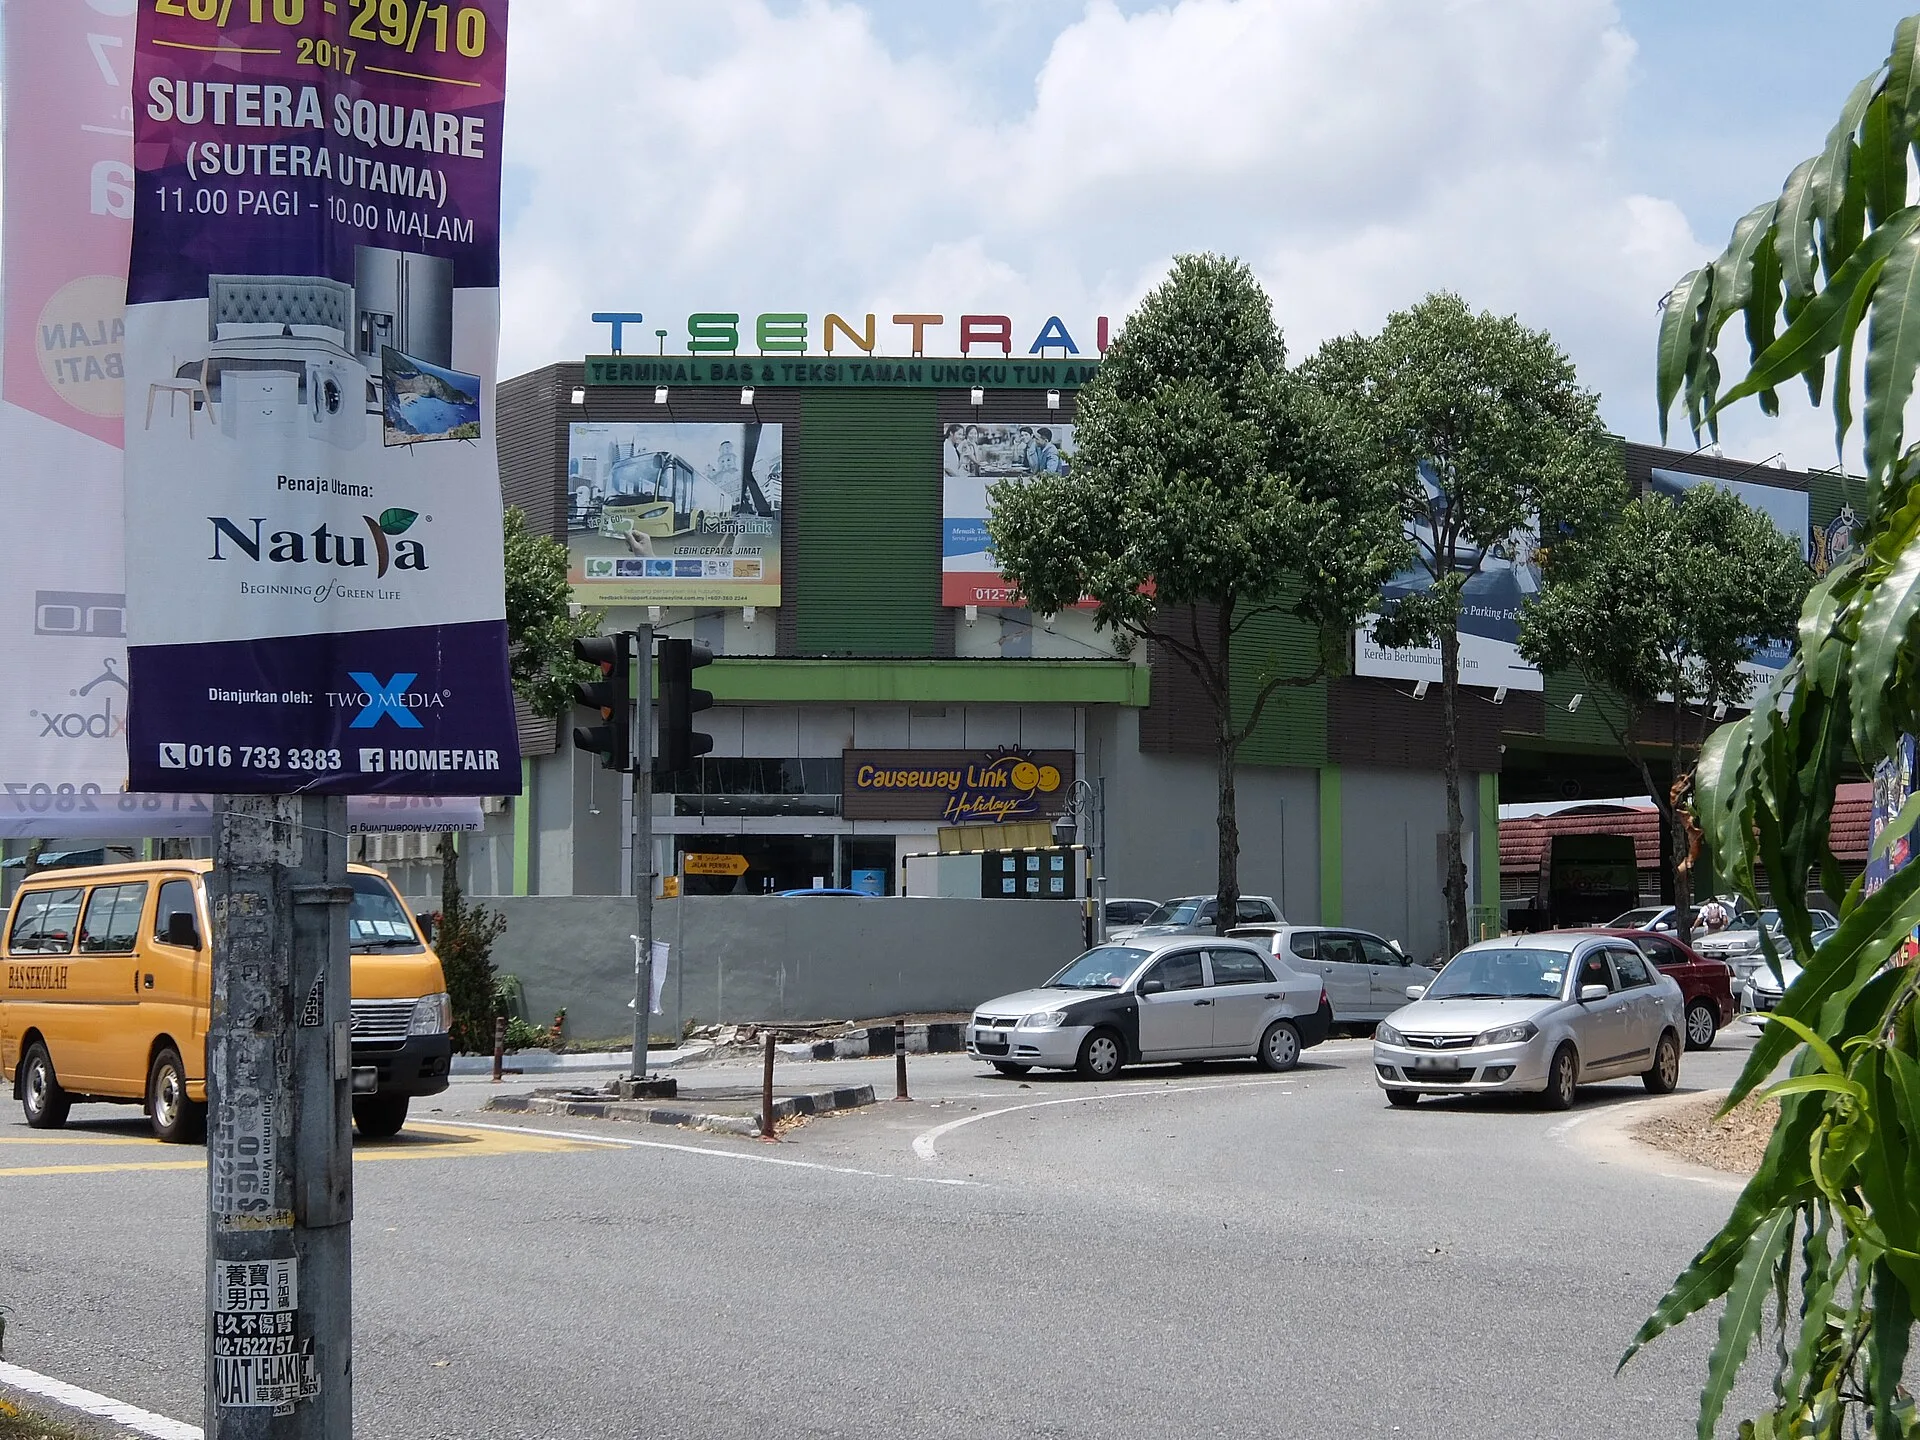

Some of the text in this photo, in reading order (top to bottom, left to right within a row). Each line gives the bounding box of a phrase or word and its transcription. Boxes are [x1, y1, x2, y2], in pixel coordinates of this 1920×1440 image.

[348, 0, 486, 58] 29/10
[296, 38, 357, 75] 2017
[147, 77, 485, 159] SUTERA SQUARE
[186, 141, 447, 208] (SUTERA UTAMA)
[156, 187, 228, 216] 11.00
[238, 189, 300, 216] PAGI
[328, 195, 379, 230] 10.00
[387, 209, 474, 244] MALAM
[591, 363, 702, 382] TERMINAL
[710, 363, 754, 382] BAS
[761, 364, 775, 382] &
[781, 364, 844, 383] TEKSI
[850, 364, 922, 383] TAMAN
[931, 365, 1006, 384] UNGKU
[1013, 366, 1055, 384] TUN
[277, 475, 374, 498] Penaja Utama:
[588, 518, 601, 528] TAP
[673, 546, 698, 555] LEBIH
[699, 546, 726, 555] CEPAT
[735, 546, 762, 555] JIMAT
[313, 578, 336, 603] of
[1470, 605, 1502, 621] Parking
[1364, 648, 1392, 661] Kereta
[1463, 657, 1479, 669] Jam
[208, 688, 313, 705] Dianjurkan oleh:
[325, 691, 444, 708] TWO MEDIA
[189, 744, 342, 770] 016 733 3383
[857, 765, 1007, 792] Causeway Link
[943, 795, 1020, 822] Holidays
[8, 966, 68, 989] BAS SEKOLAH
[260, 1093, 274, 1195] Pinjaman Wang
[237, 1136, 260, 1193] 016
[255, 1354, 298, 1386] LELAKI
